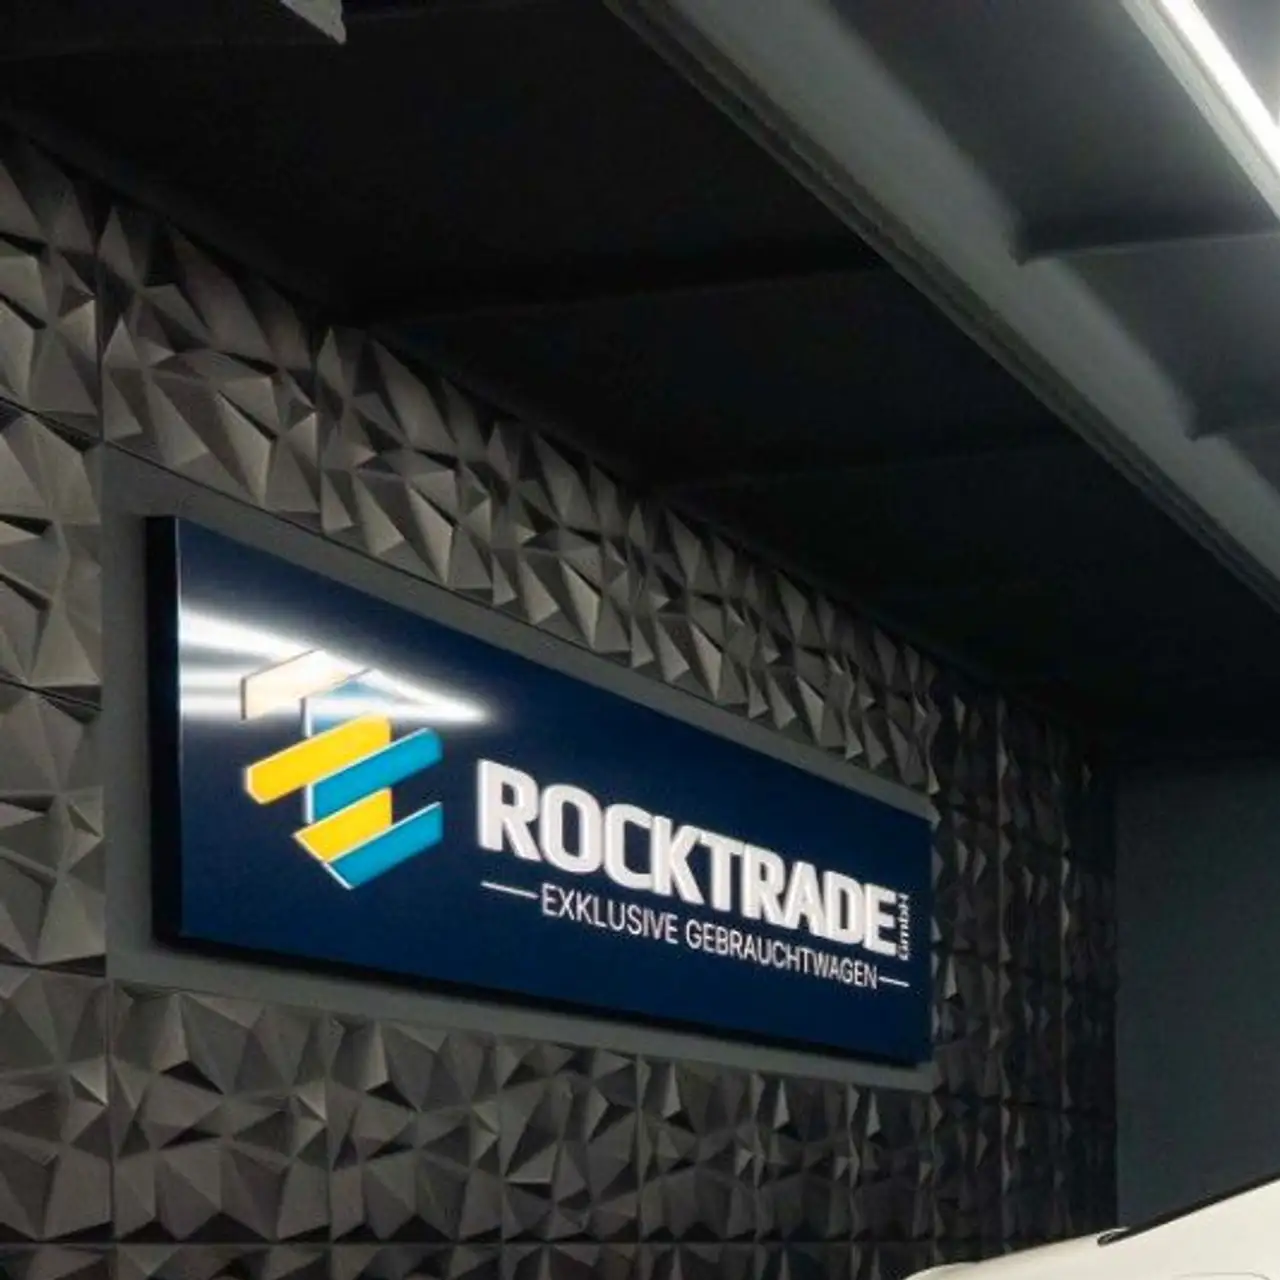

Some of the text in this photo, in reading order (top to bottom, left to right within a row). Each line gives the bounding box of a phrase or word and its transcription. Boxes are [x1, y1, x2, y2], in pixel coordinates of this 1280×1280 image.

[477, 758, 898, 957] ROCKTRADE
[541, 882, 878, 990] EXKLUSIVE GEBRAUCHTWAGEN
